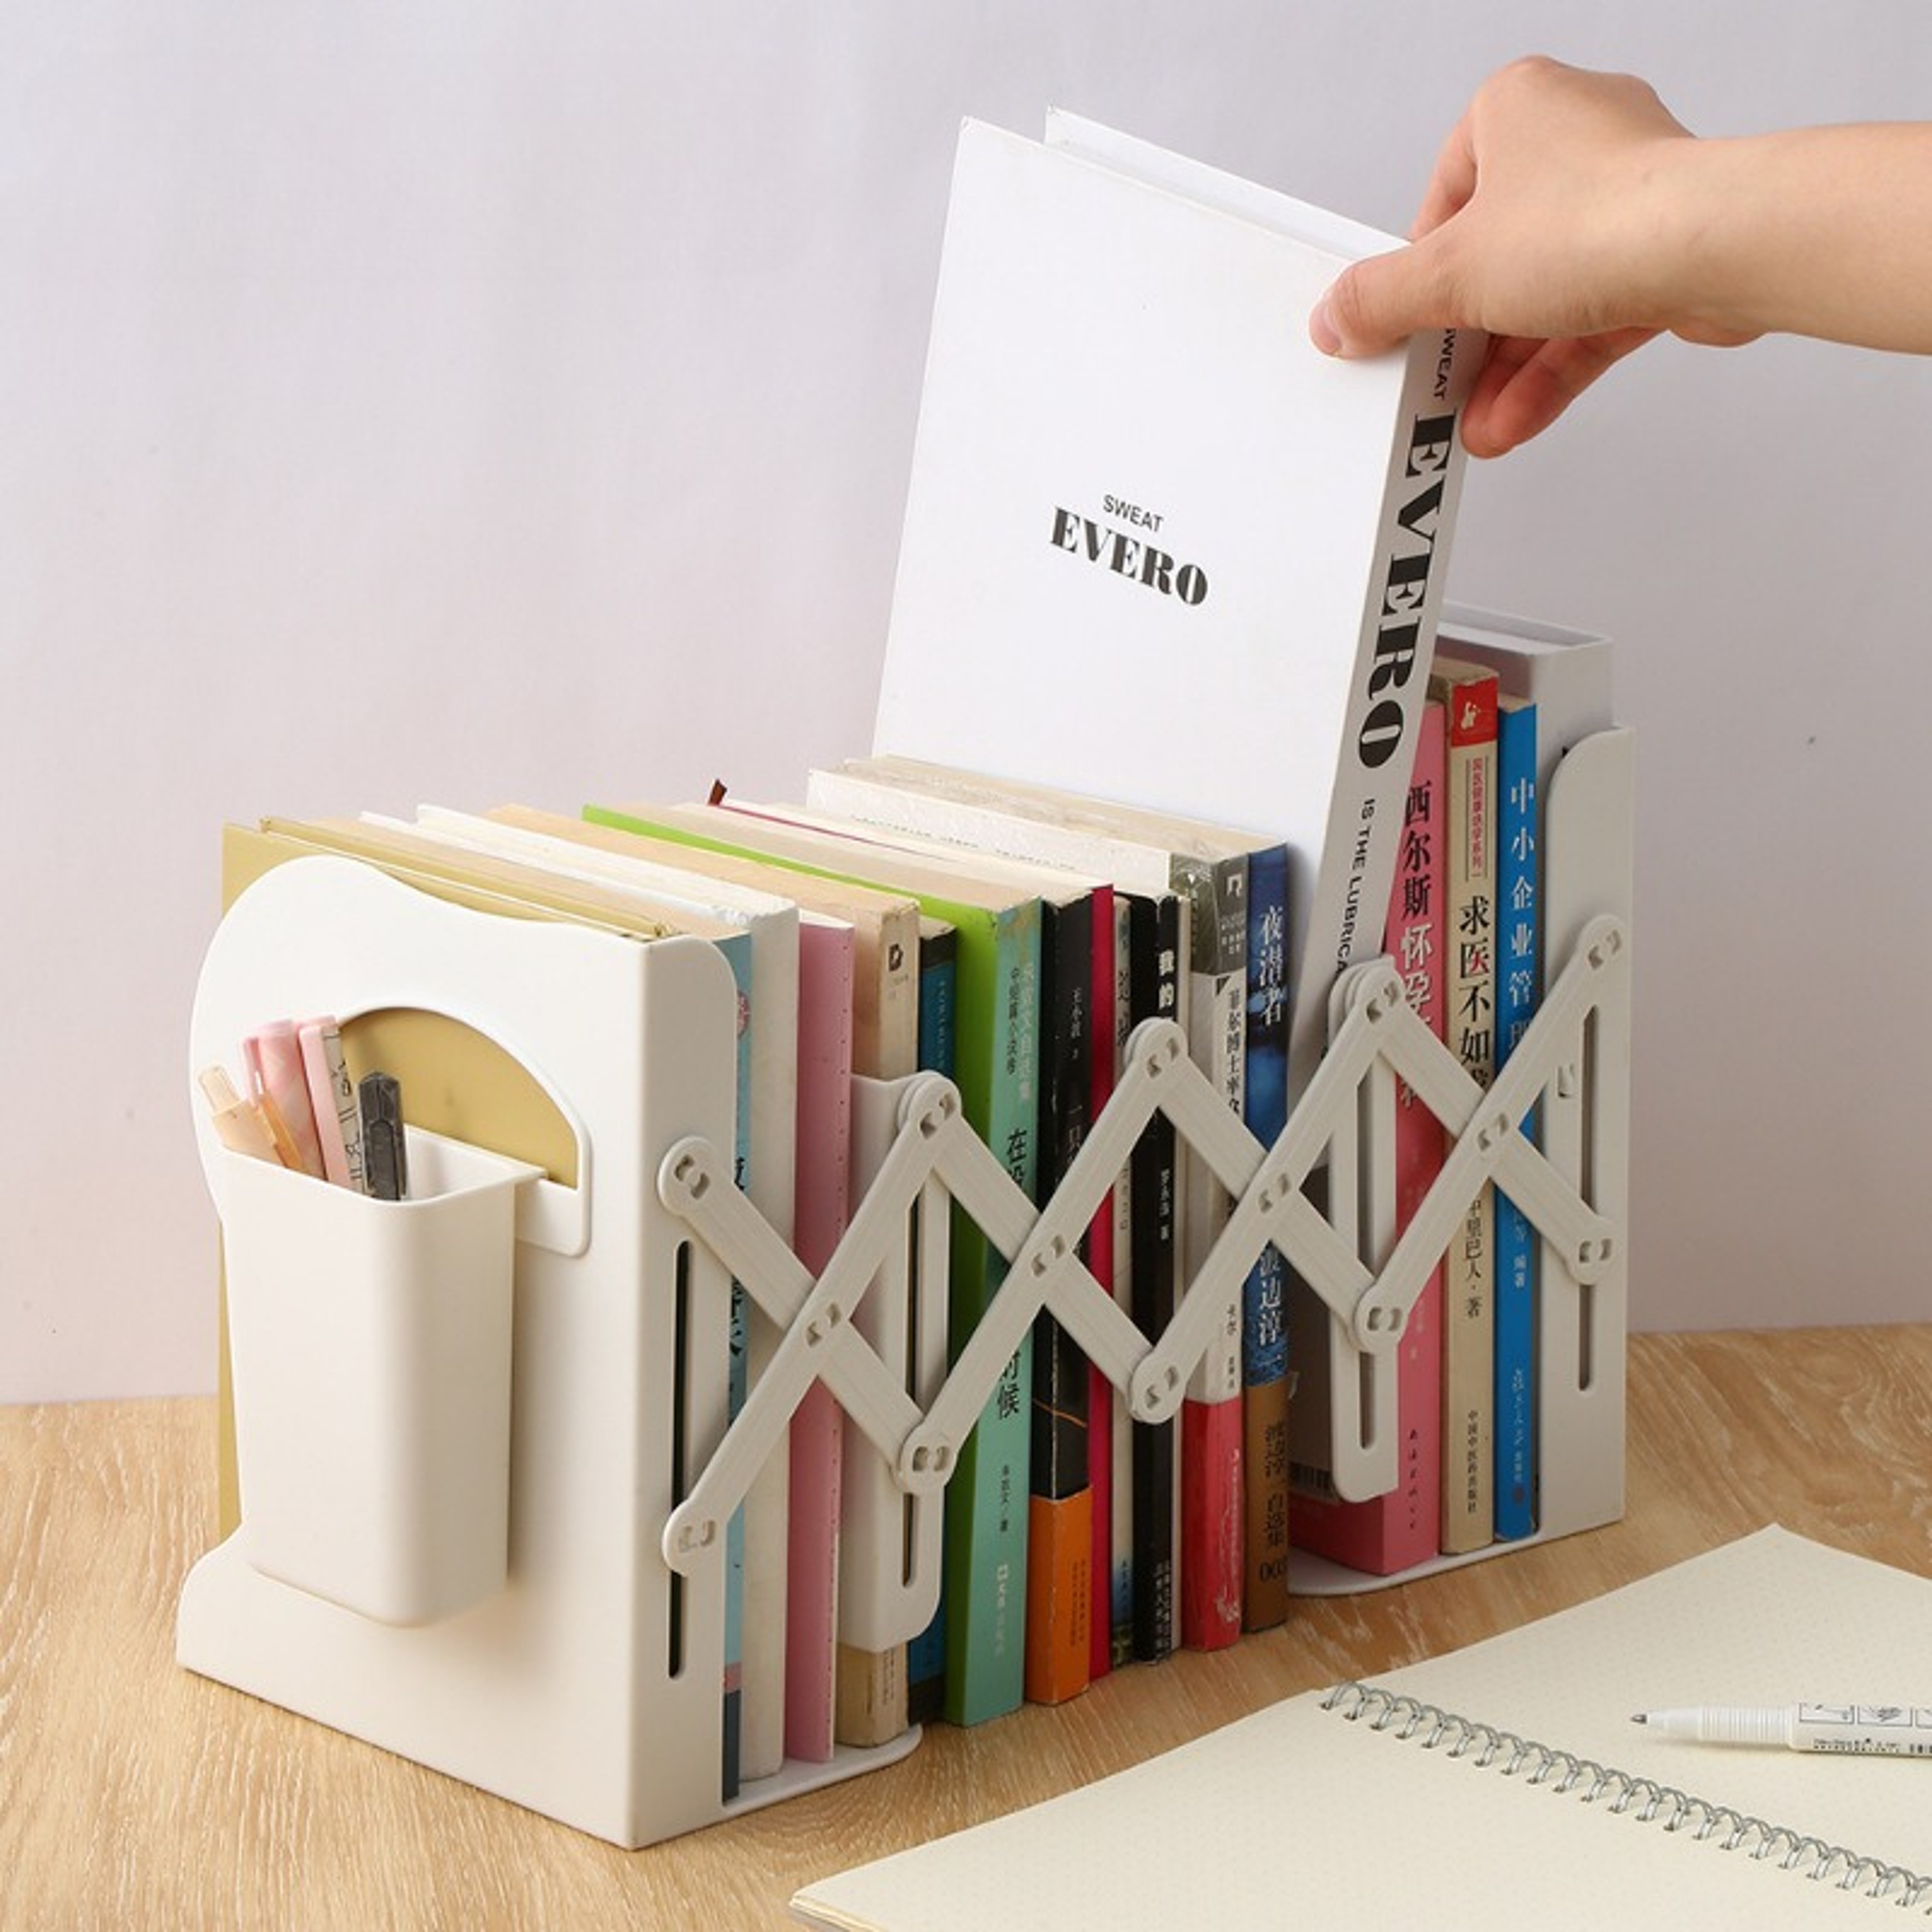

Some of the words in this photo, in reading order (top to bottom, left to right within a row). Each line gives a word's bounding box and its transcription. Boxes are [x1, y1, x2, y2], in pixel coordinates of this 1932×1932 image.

[1433, 328, 1457, 400] WEAT
[1050, 506, 1208, 605] EVERO
[1103, 494, 1164, 532] SWEAT
[1359, 407, 1457, 769] EVERO
[1352, 826, 1372, 871] THE
[1361, 798, 1376, 820] IS
[1399, 781, 1434, 1107] 西尔斯怀孕
[1459, 896, 1490, 1086] 求医不如
